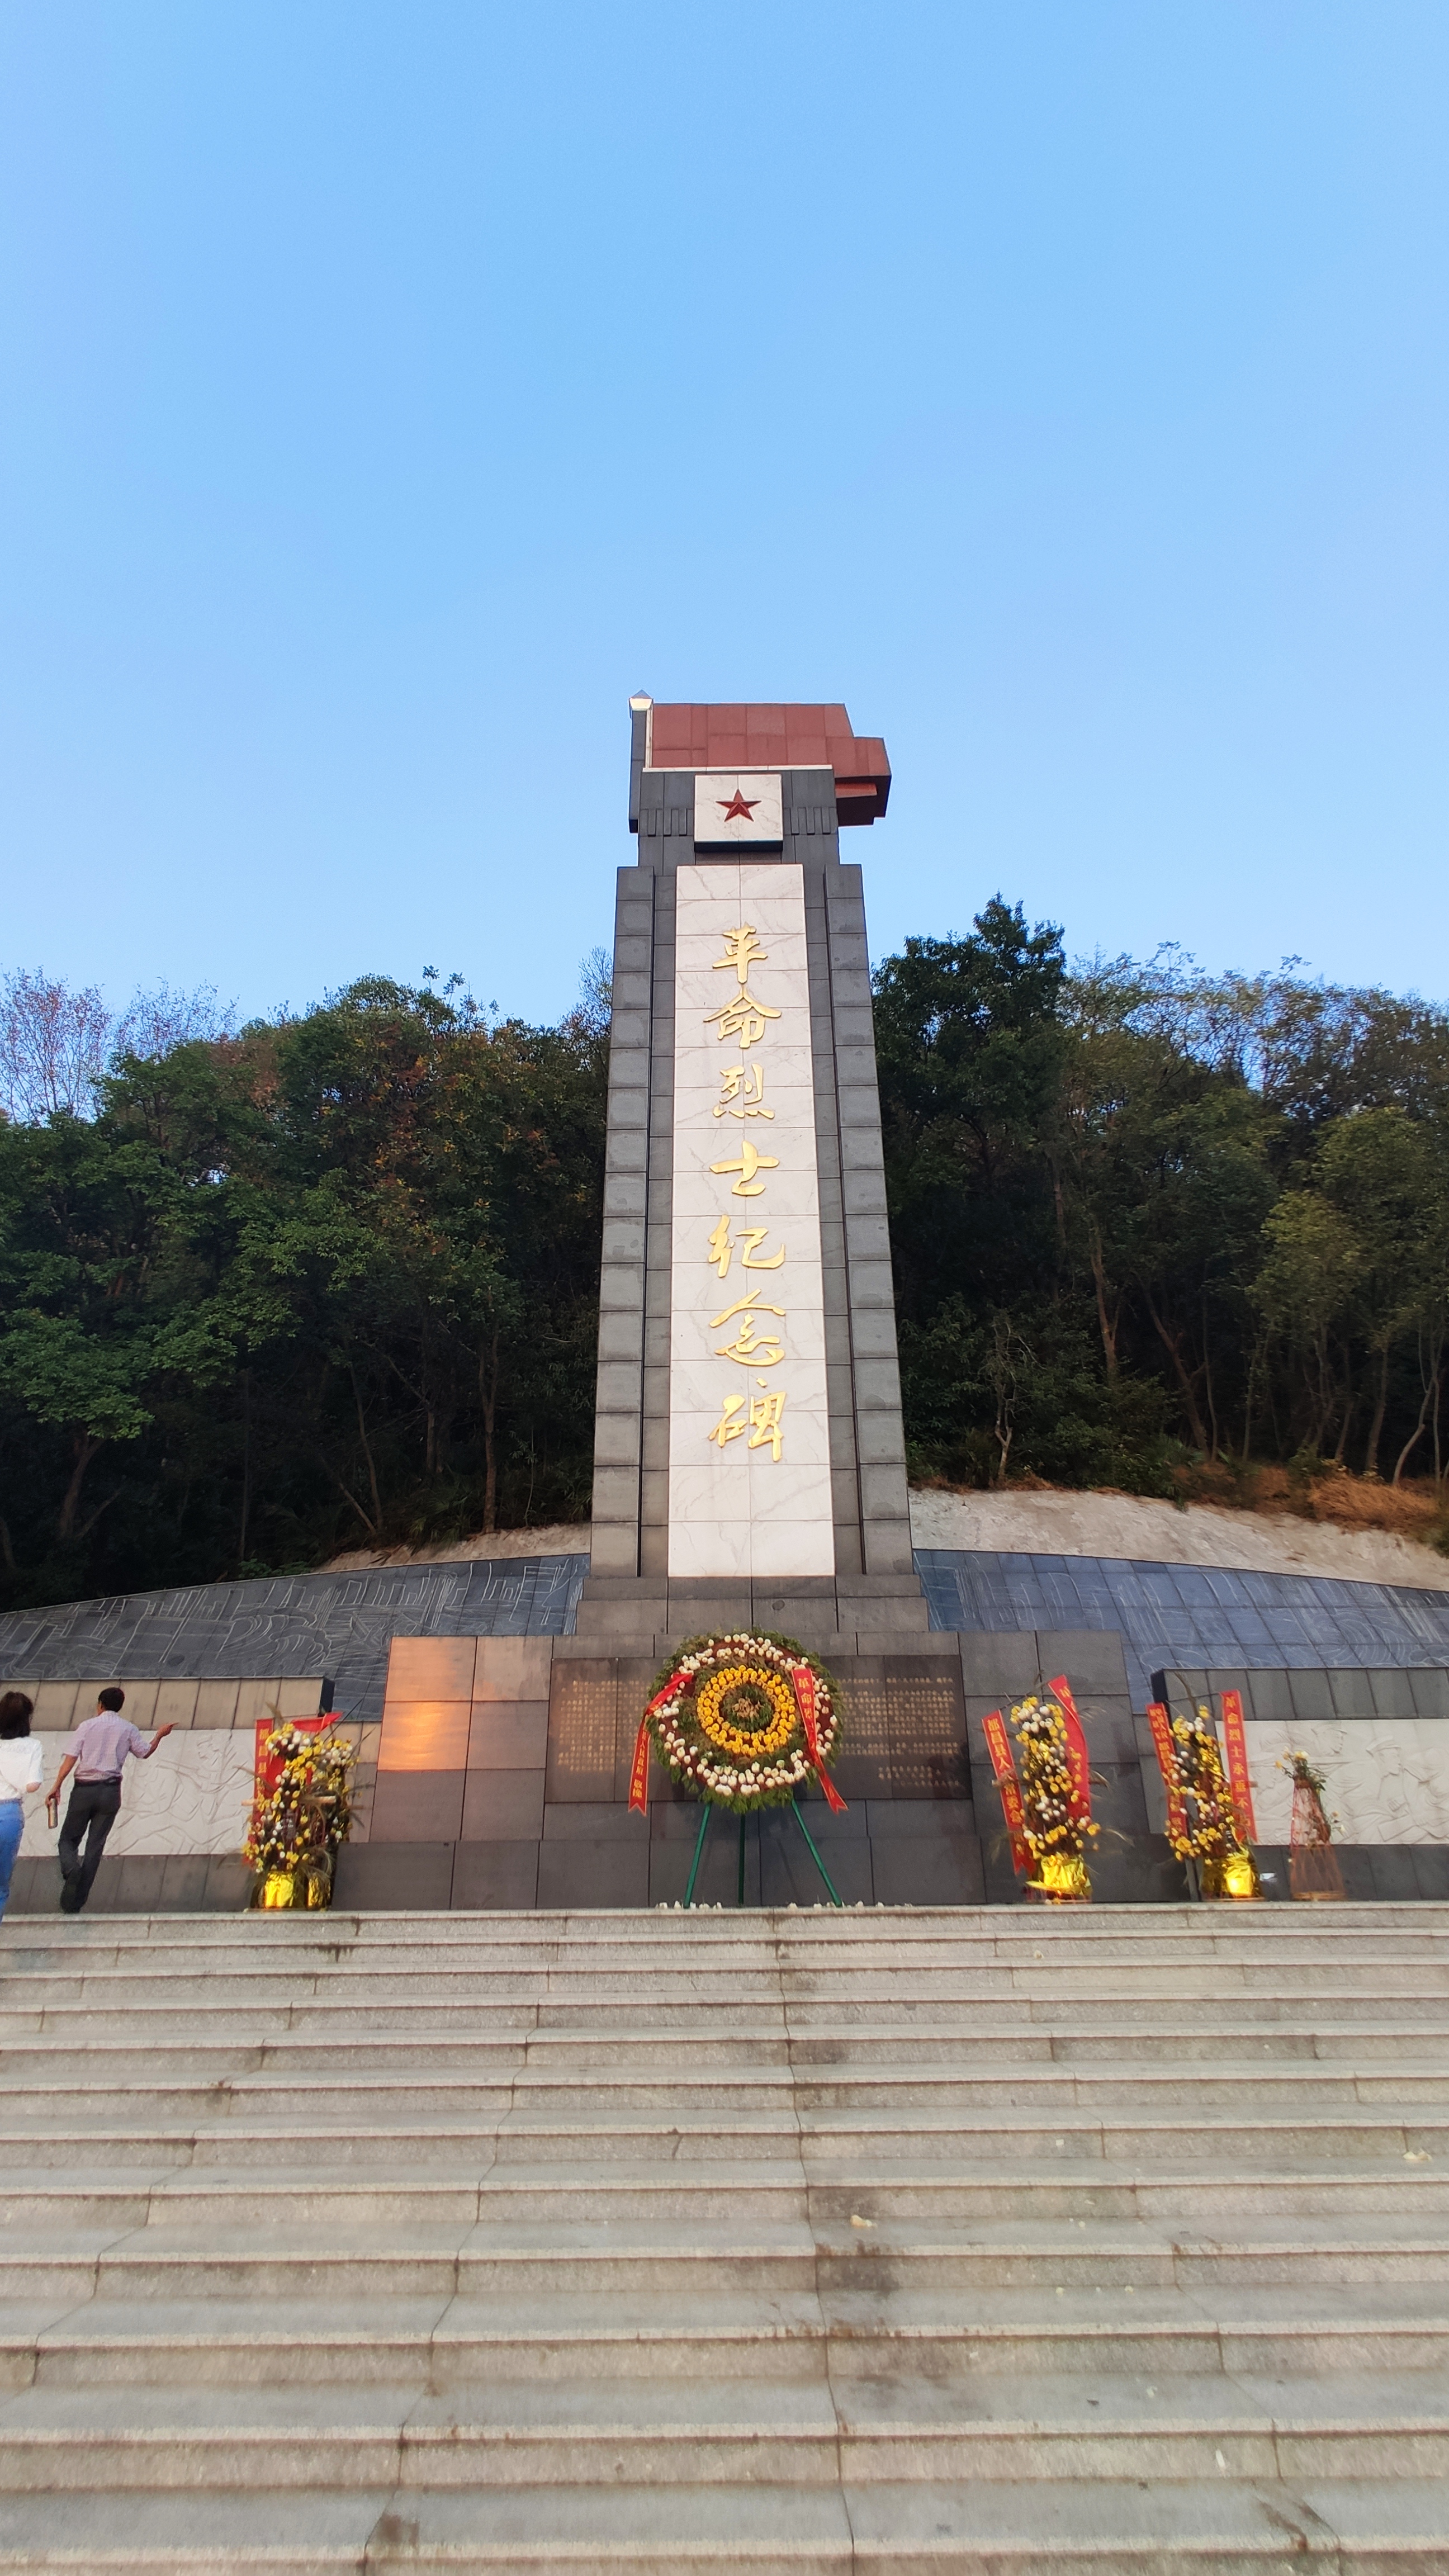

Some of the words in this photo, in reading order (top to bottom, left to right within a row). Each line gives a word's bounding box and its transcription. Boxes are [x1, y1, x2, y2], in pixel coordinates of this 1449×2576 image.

[703, 922, 787, 1462] 革命烈士纪念碑
